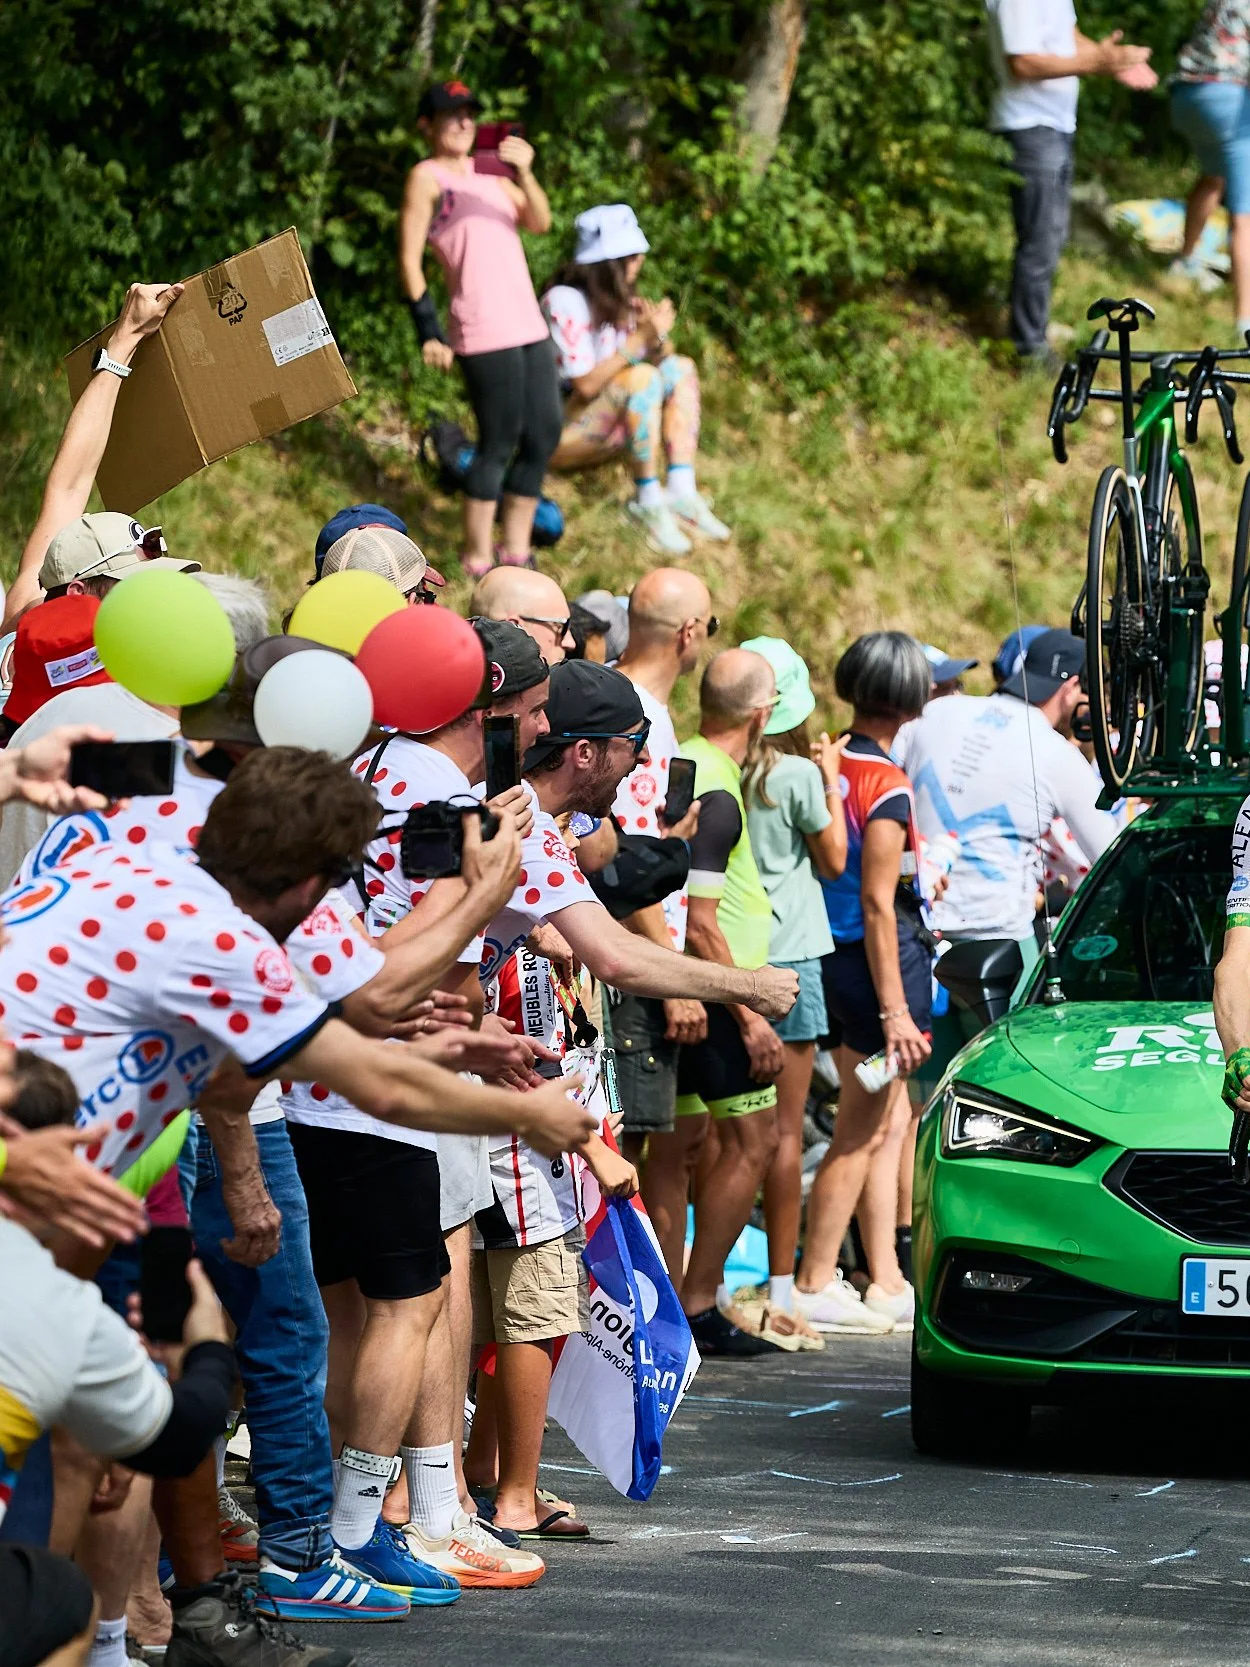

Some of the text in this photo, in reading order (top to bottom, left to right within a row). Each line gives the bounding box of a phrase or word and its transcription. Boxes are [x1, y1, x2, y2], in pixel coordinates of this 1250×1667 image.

[228, 314, 244, 326] PAP
[525, 975, 545, 1037] MEUBLES
[1190, 1292, 1200, 1304] E
[448, 1539, 503, 1572] TERREX
